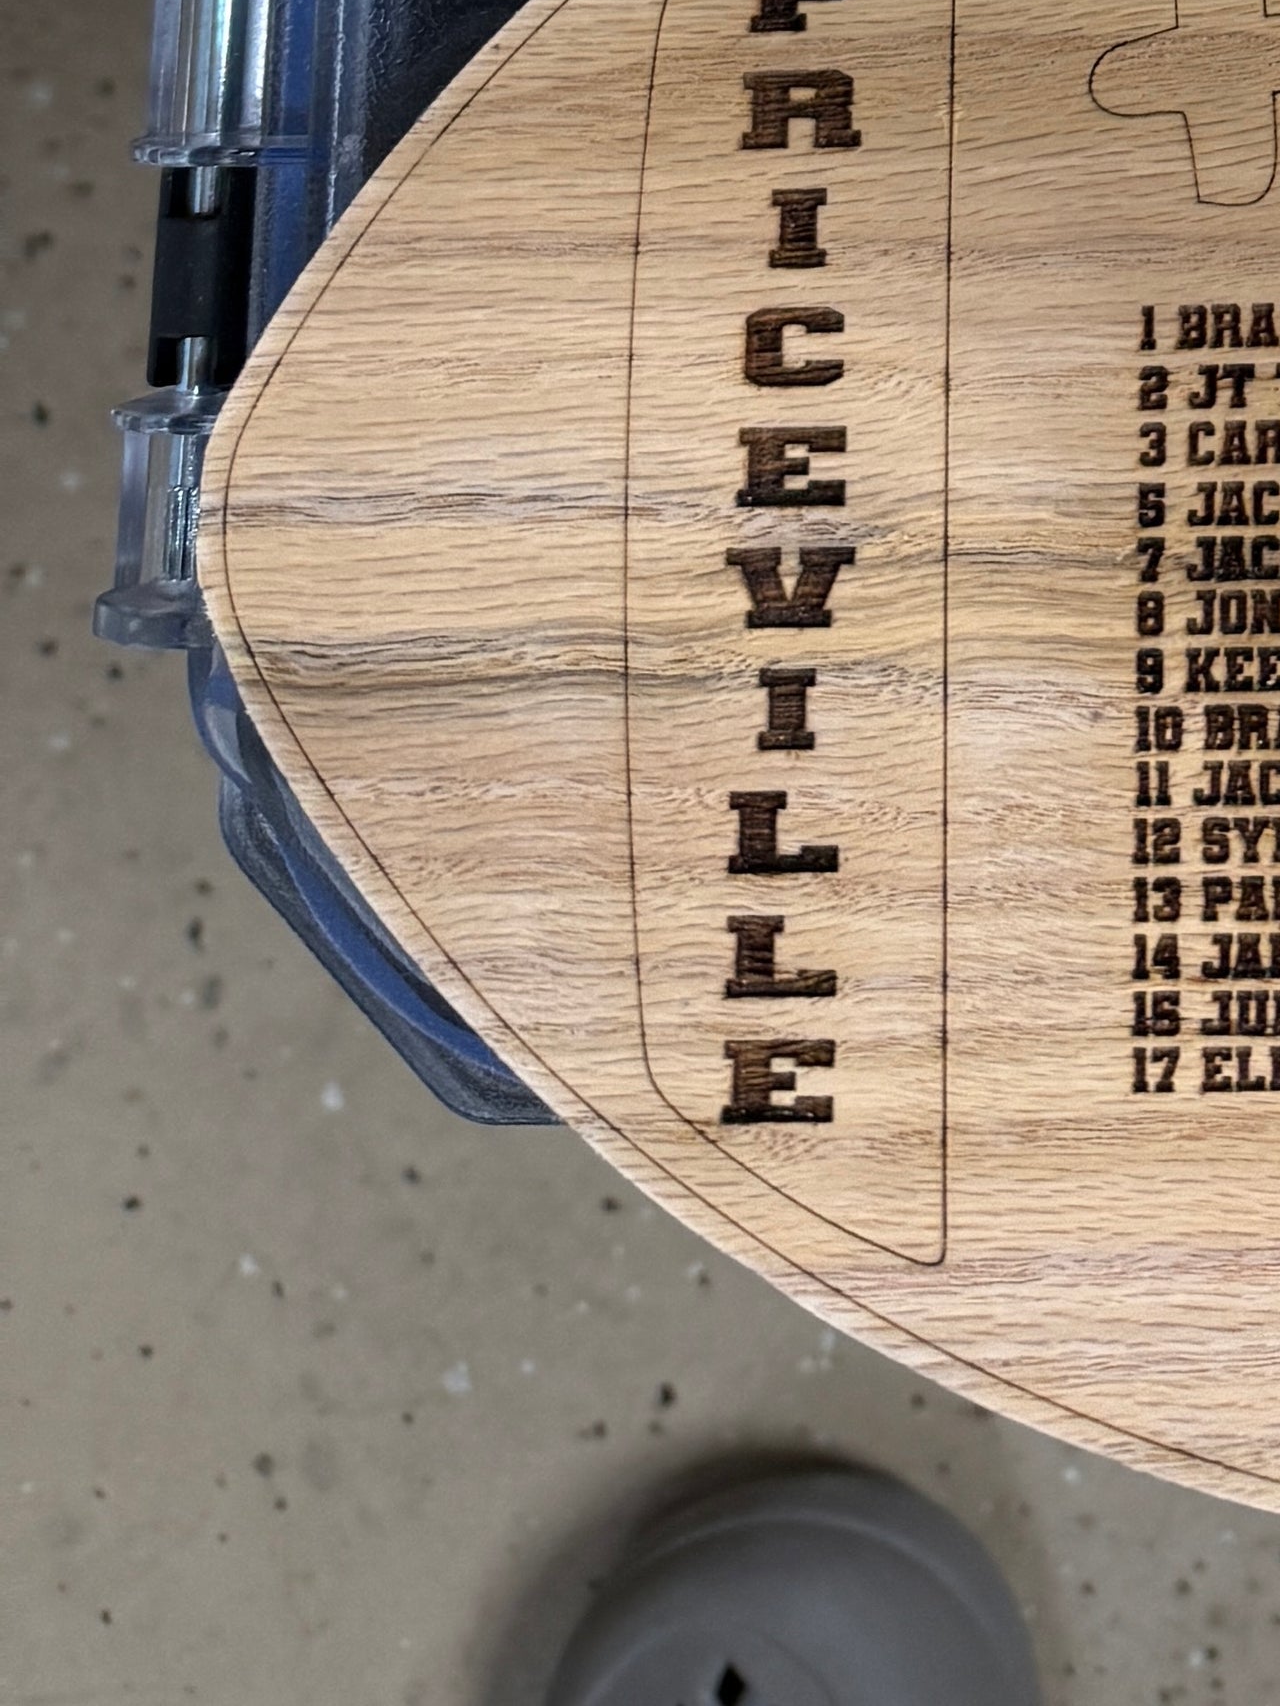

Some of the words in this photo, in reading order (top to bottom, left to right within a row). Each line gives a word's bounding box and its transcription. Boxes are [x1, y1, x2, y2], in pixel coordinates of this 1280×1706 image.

[1139, 306, 1156, 350] 1
[1138, 366, 1168, 409] 2
[1189, 363, 1255, 408] JT
[1139, 423, 1167, 467] 3
[1138, 484, 1166, 527] 5
[1137, 537, 1164, 581] 7
[1136, 592, 1164, 636] 8
[1136, 648, 1164, 693] 9
[1135, 707, 1183, 751] 10
[1136, 763, 1170, 806] 11
[1134, 819, 1181, 863] 12
[1134, 877, 1181, 921] 13
[1133, 936, 1180, 979] 14
[1133, 992, 1180, 1036] 15
[1132, 1048, 1180, 1093] 17
